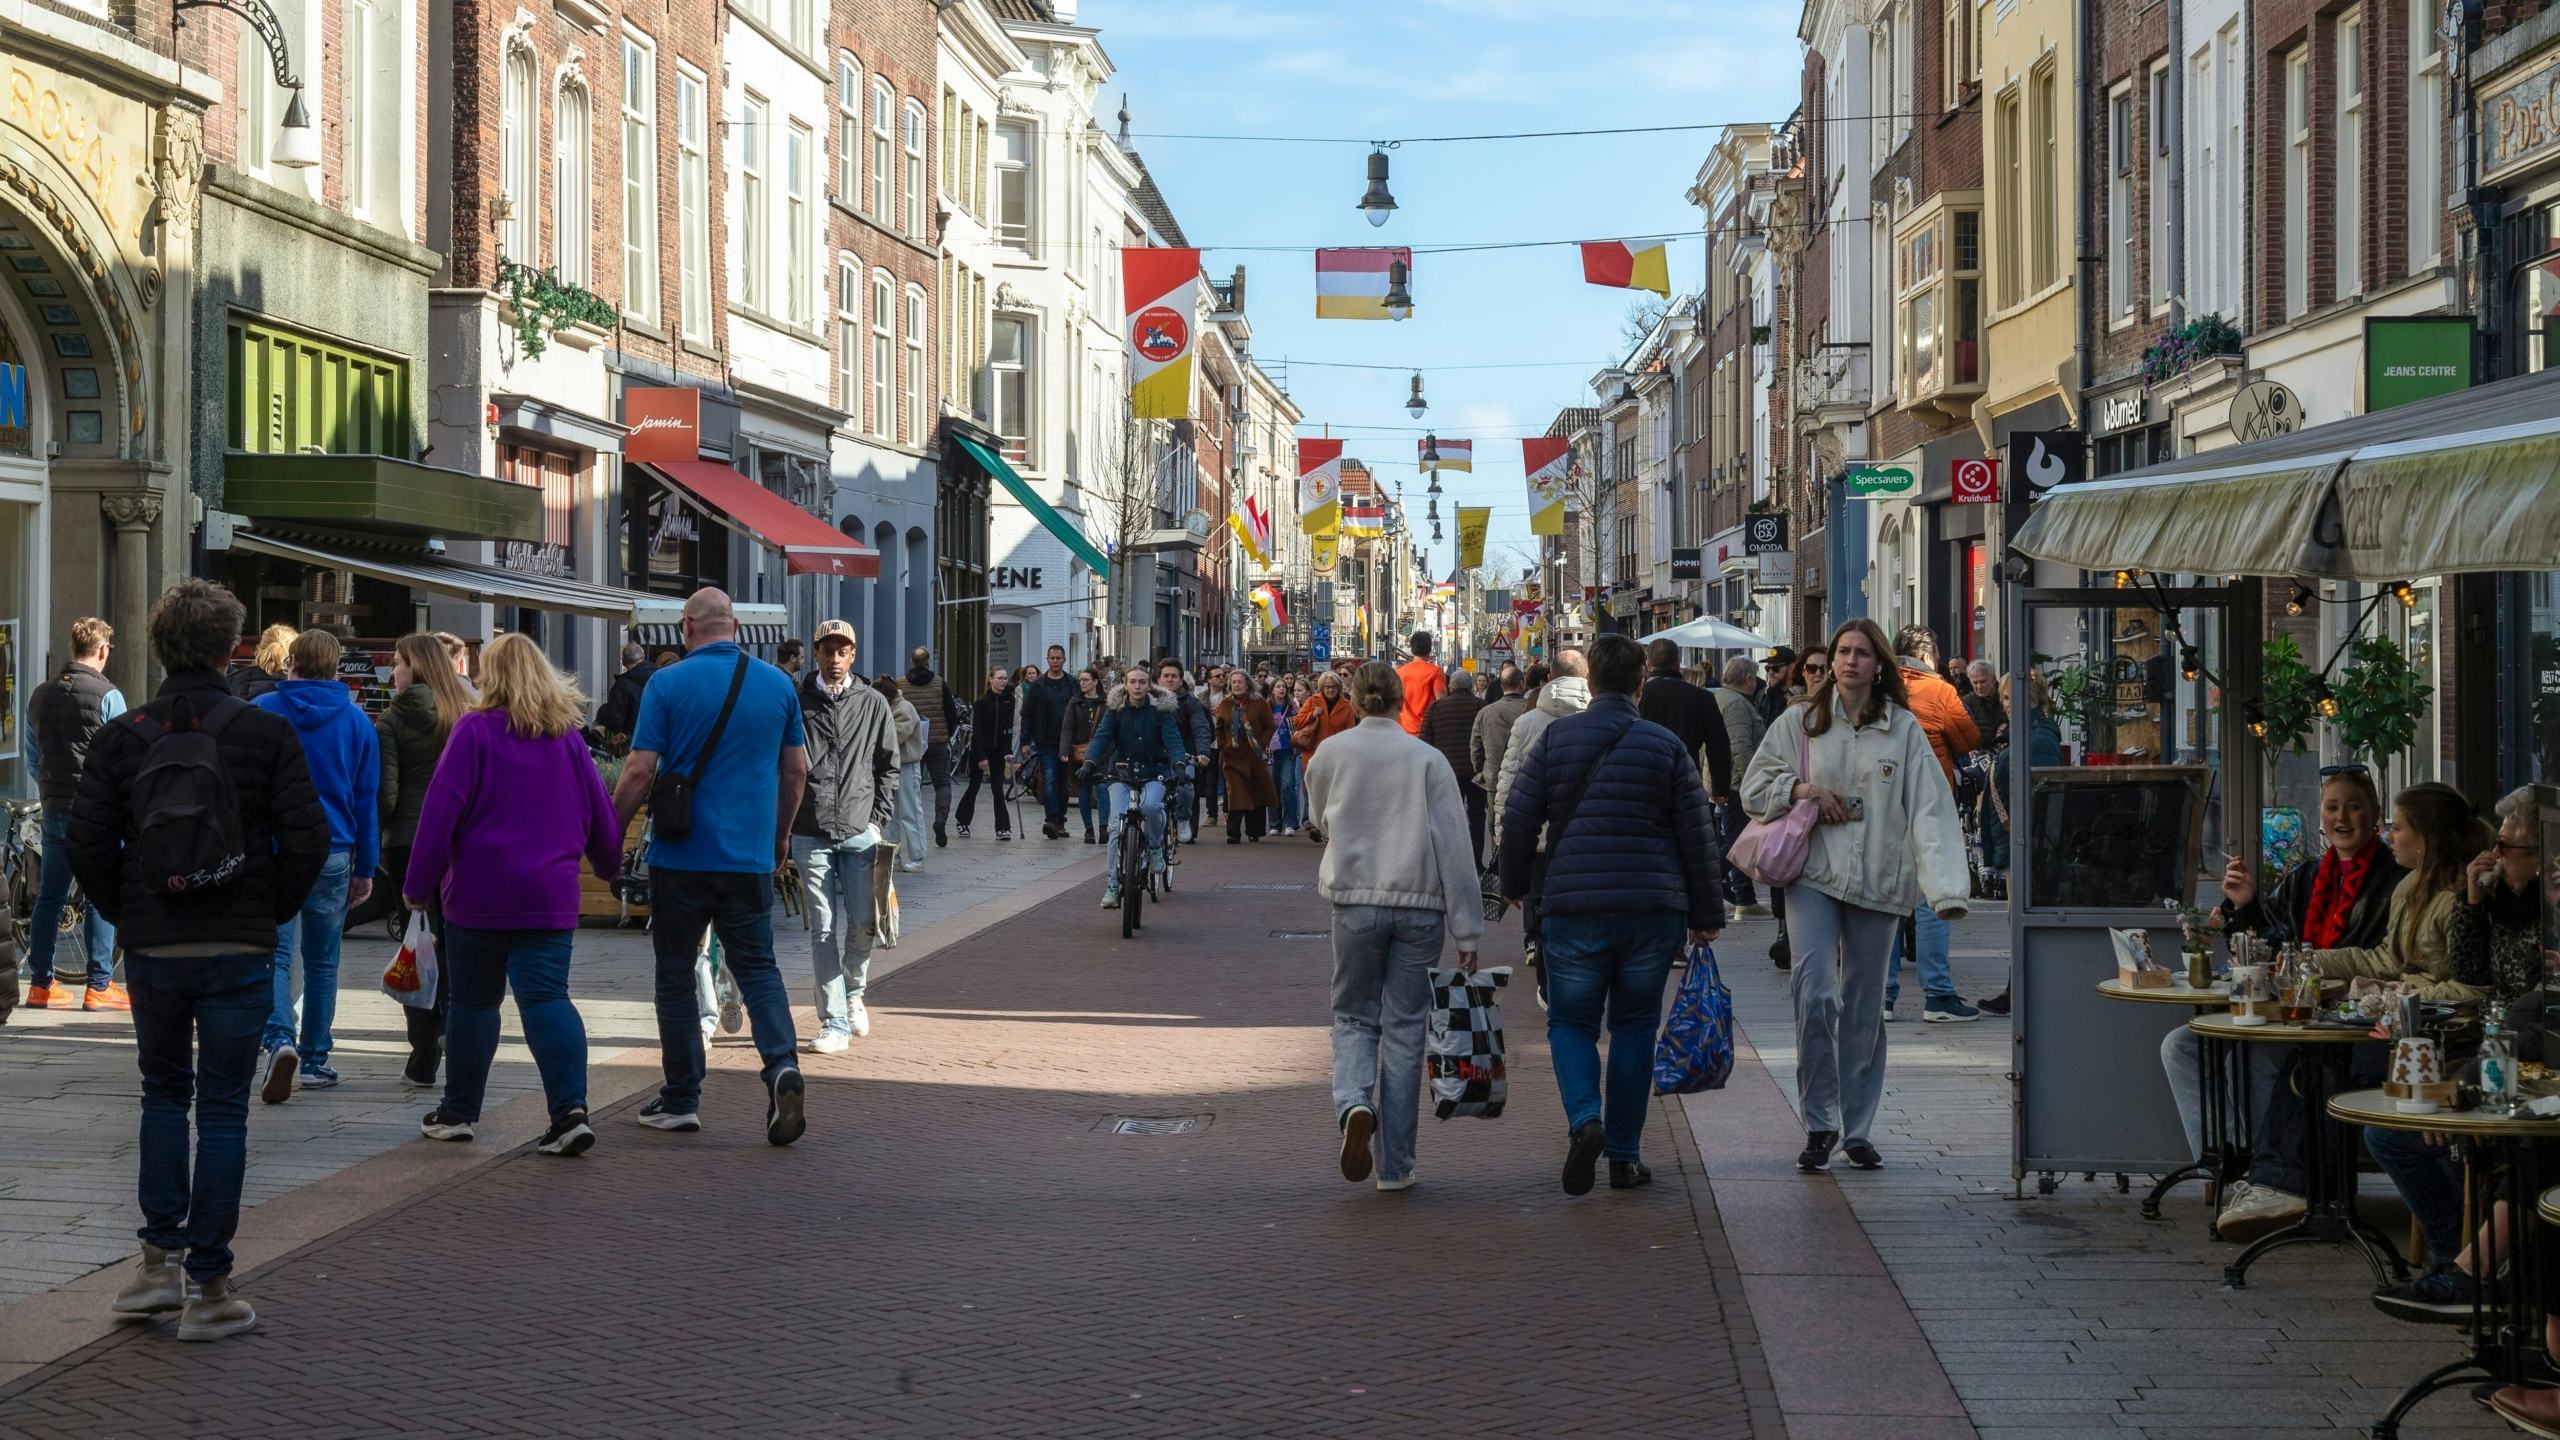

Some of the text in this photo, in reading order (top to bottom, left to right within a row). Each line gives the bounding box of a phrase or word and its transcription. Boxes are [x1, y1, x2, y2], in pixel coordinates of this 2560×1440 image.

[2383, 366, 2457, 377] JEANS CENTRE
[630, 415, 693, 436] jamin
[1855, 475, 1908, 487] Specsavers
[1958, 494, 1992, 503] Kruidvat
[1749, 543, 1784, 552] OMODA
